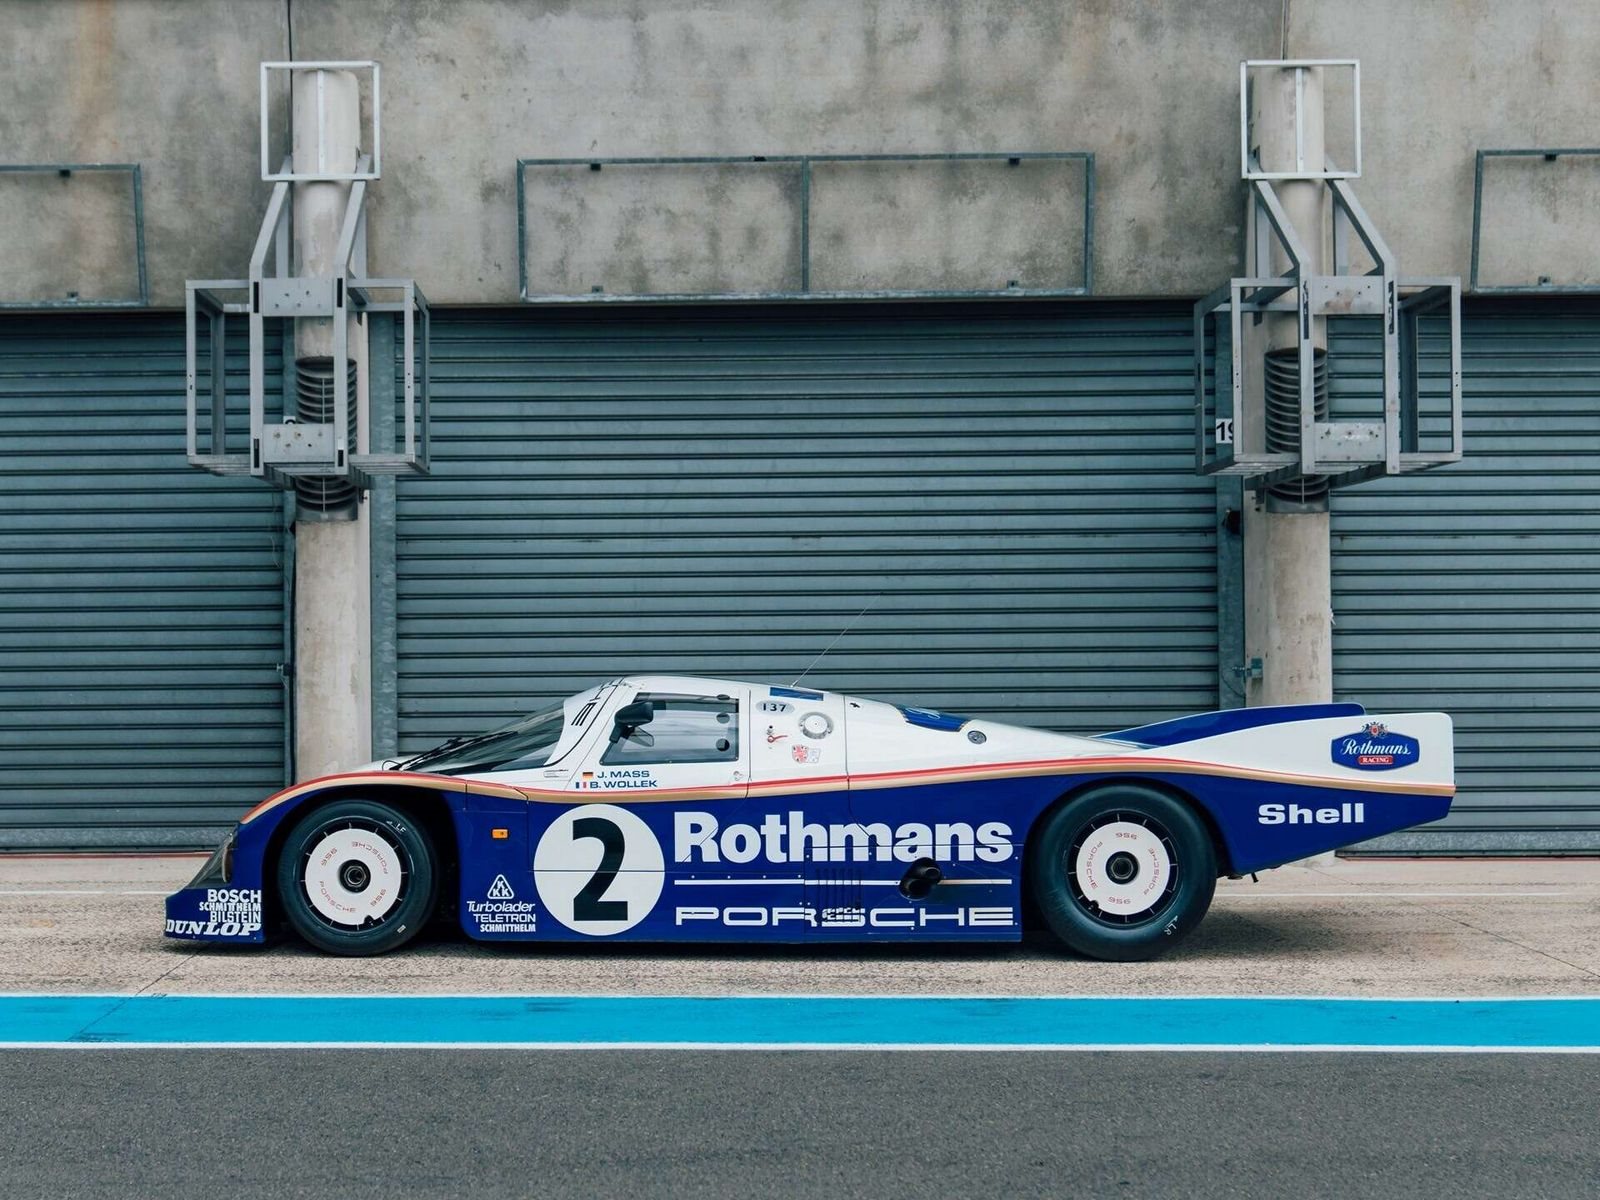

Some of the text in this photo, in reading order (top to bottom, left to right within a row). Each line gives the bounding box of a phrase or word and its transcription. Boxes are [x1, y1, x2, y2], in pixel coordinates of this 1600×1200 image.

[762, 703, 787, 712] 137
[1341, 738, 1412, 755] Rothmans
[597, 770, 650, 779] J. MASS
[589, 780, 658, 789] B. WOLLEK
[1258, 803, 1364, 825] Shell
[674, 810, 1014, 864] Rothmans
[1115, 832, 1138, 840] 956
[572, 816, 629, 922] 2
[1086, 841, 1104, 890] PORSCHE
[207, 889, 262, 903] BOSCH
[1107, 896, 1131, 905] 956
[199, 901, 262, 912] SCHMITTHELM
[466, 901, 536, 912] Turbolader
[210, 911, 262, 923] BILSTEIN
[473, 913, 536, 923] TELETRON
[675, 907, 1014, 927] PORSCHE
[165, 919, 262, 936] DUNLOP
[480, 923, 536, 932] SCHMITTHELM
